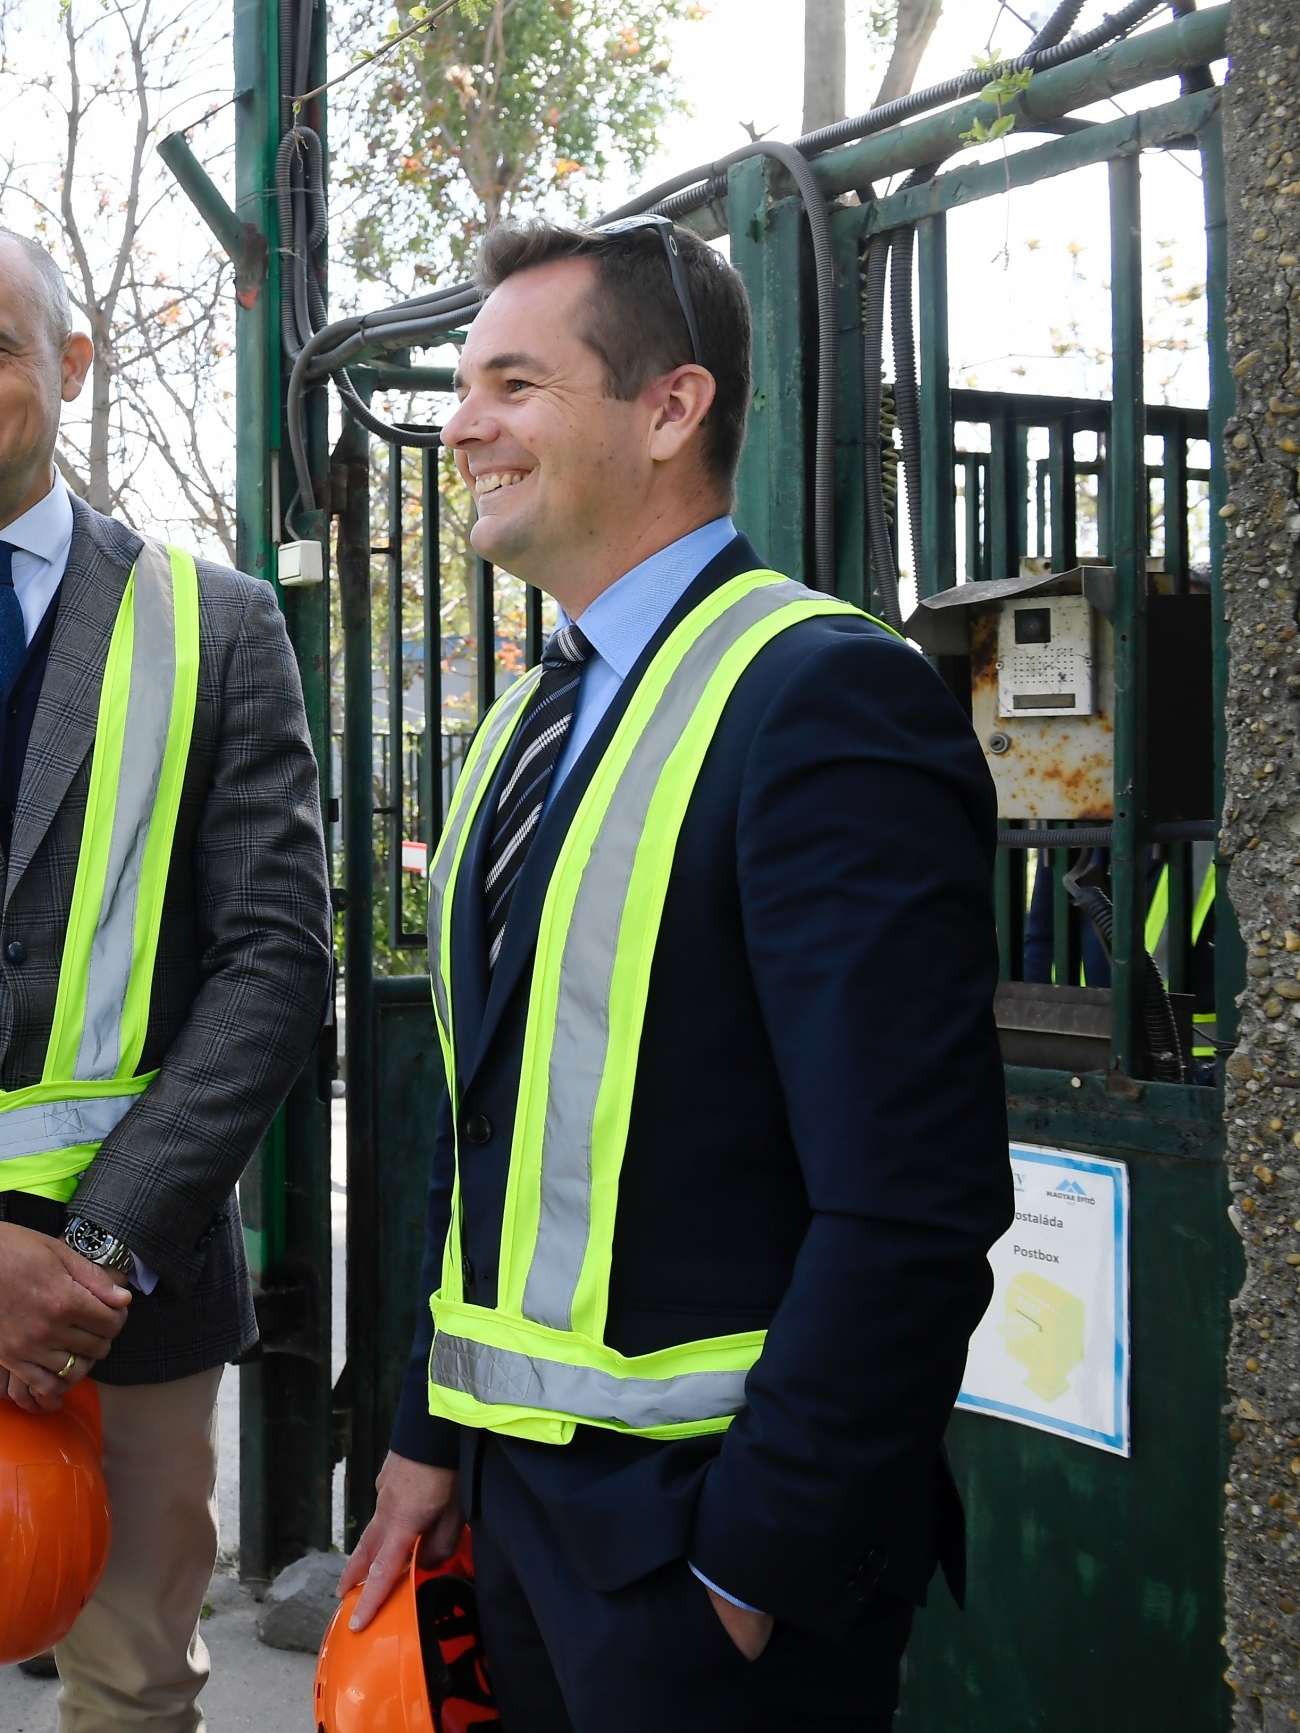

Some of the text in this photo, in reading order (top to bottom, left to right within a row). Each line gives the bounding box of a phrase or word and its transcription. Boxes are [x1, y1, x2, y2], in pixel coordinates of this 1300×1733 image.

[1046, 1191, 1076, 1201] MAGYAR
[1015, 1212, 1064, 1228] ostaláda
[1013, 1245, 1059, 1264] Postbox
